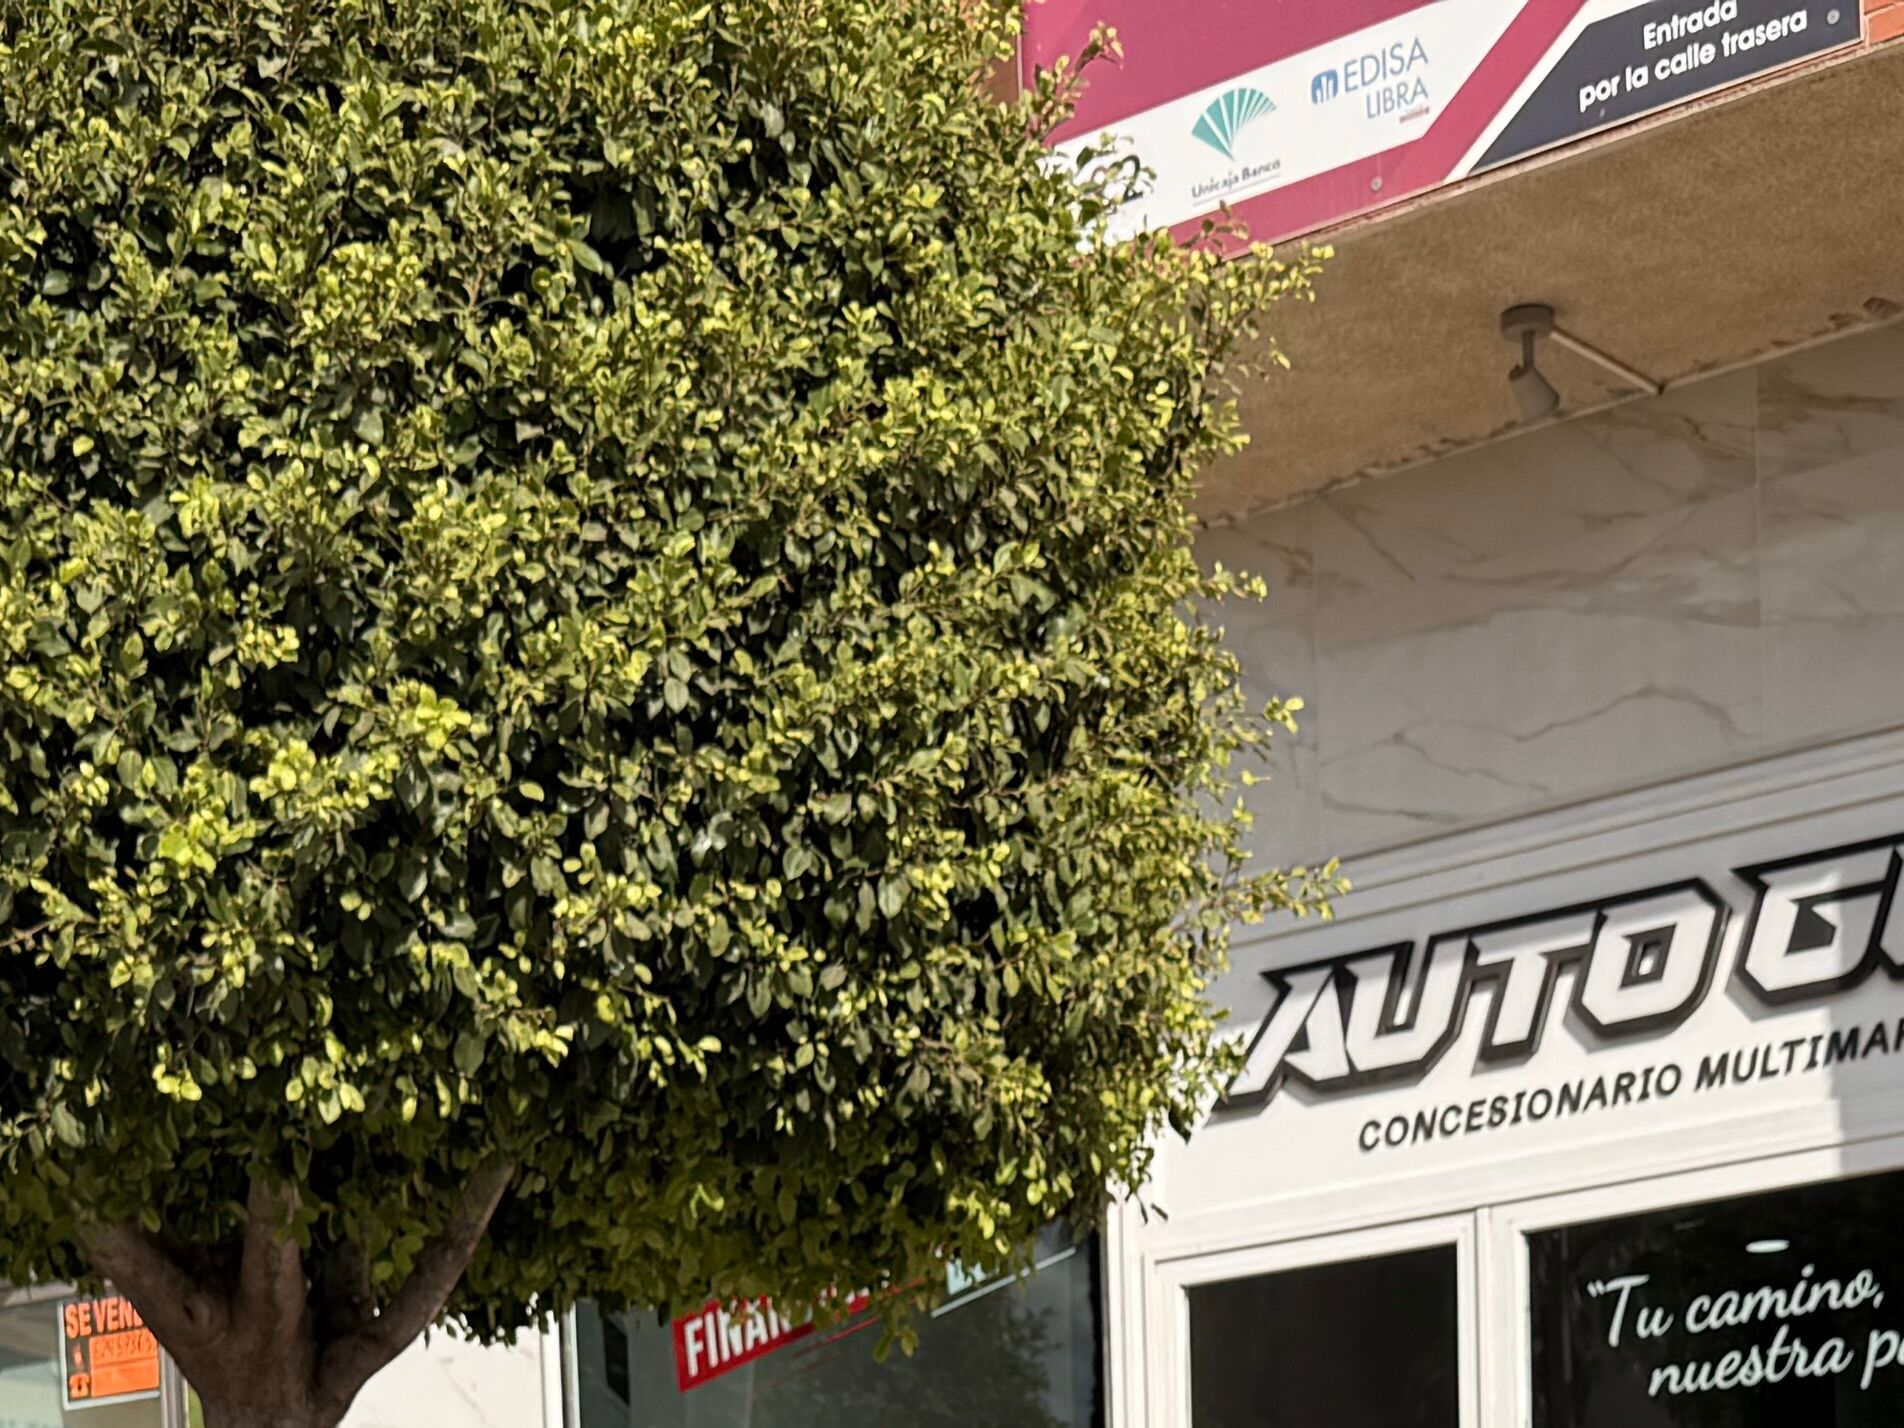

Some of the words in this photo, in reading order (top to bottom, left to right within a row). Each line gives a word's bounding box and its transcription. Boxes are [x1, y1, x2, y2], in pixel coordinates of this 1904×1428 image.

[1643, 0, 1738, 50] Entrada
[1344, 37, 1429, 93] EDISA
[1579, 75, 1620, 113] por
[1625, 63, 1649, 92] la
[1654, 41, 1716, 81] calle
[1721, 9, 1808, 57] trasera
[1366, 77, 1429, 120] LIBRA
[1357, 1063, 1683, 1153] CONCESIONARIO
[65, 1302, 92, 1340] SE
[1684, 1263, 1886, 1334] camino,
[1647, 1324, 1855, 1398] nuestra
